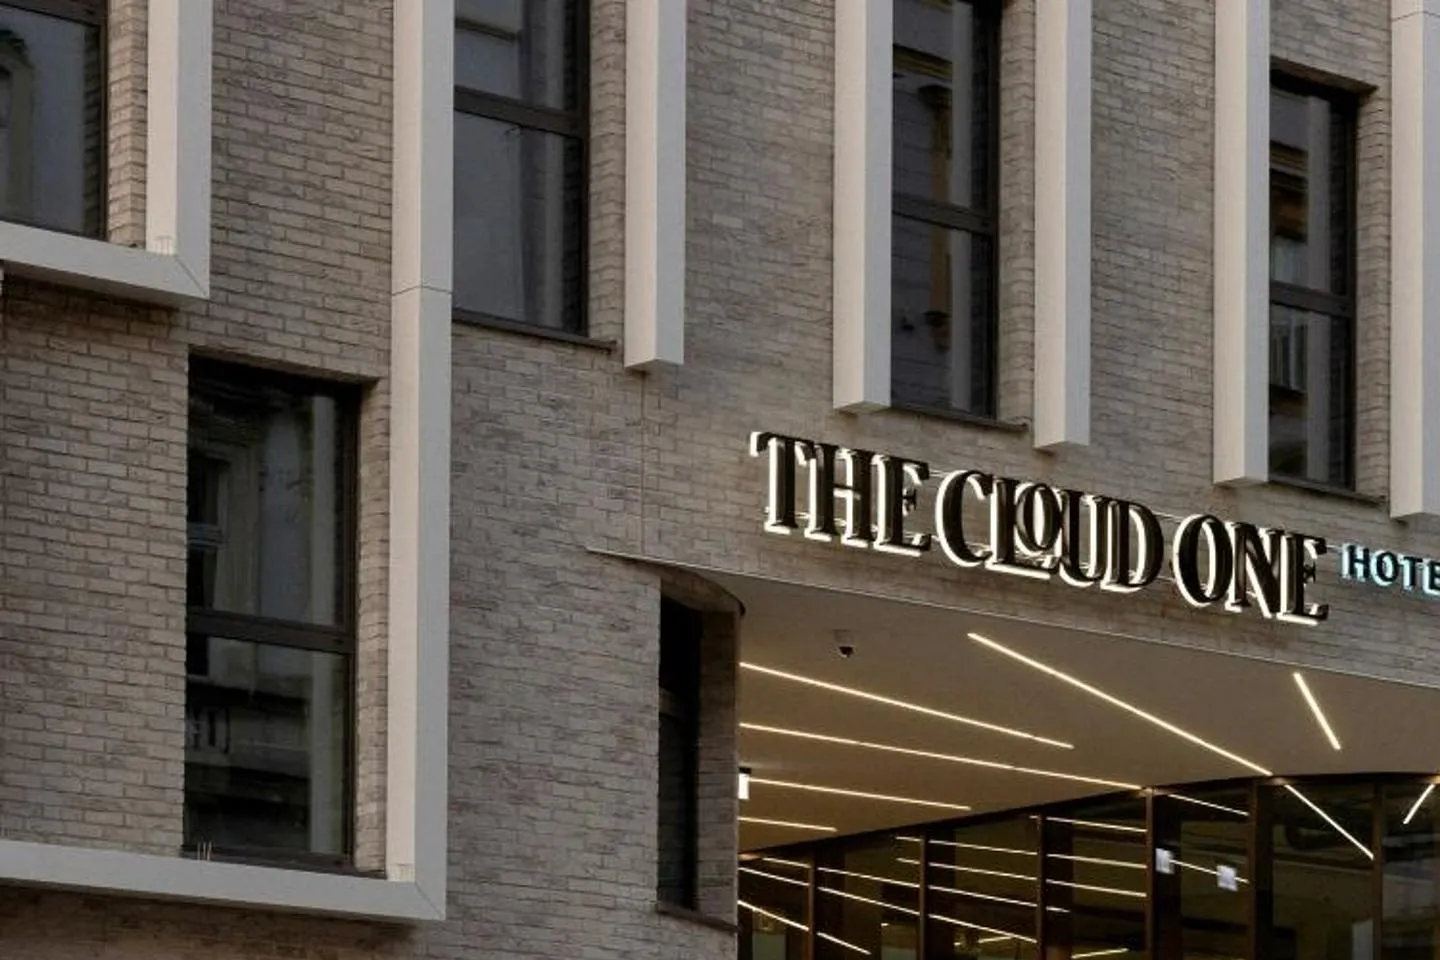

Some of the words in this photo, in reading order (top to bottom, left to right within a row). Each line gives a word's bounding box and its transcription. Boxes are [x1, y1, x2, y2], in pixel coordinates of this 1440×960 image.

[750, 431, 931, 557] THE
[935, 470, 1163, 593] CLOUD
[1172, 514, 1329, 626] ONE
